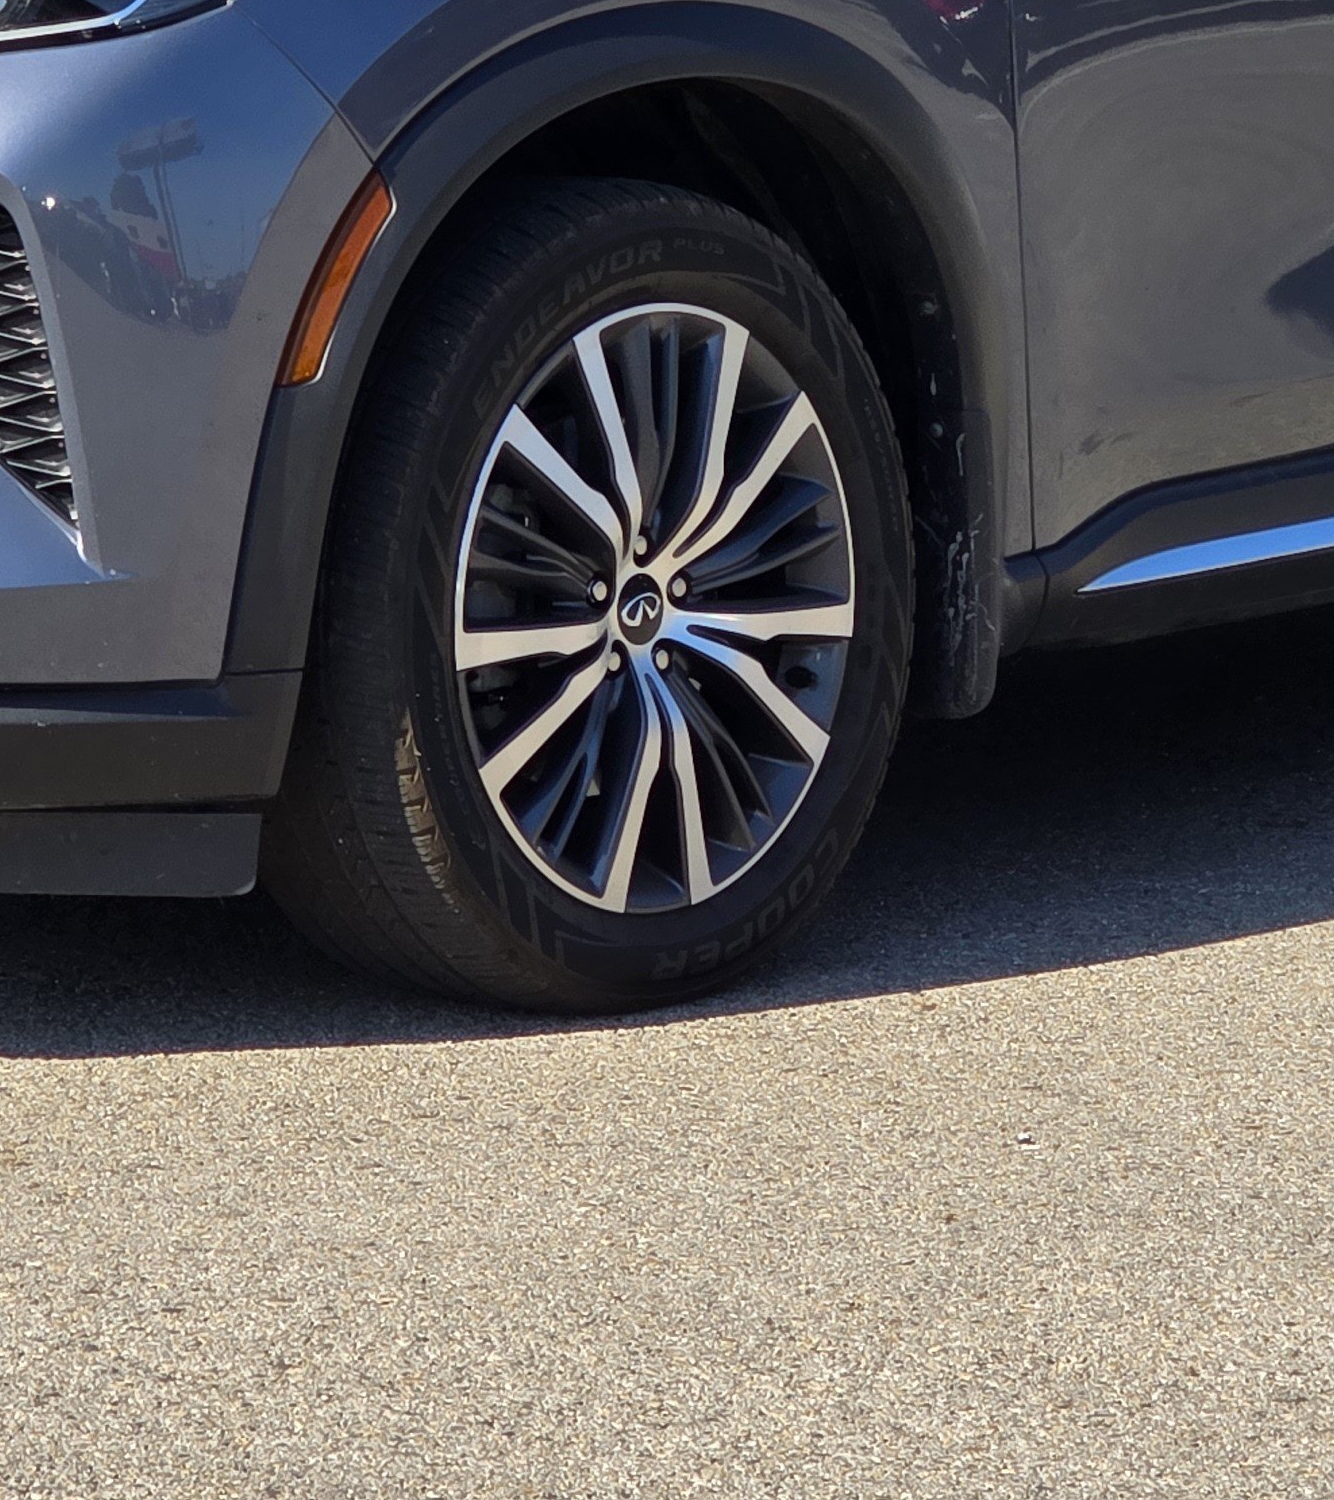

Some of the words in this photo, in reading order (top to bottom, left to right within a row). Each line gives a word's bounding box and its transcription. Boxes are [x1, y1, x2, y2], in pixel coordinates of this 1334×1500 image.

[673, 236, 726, 257] PLUS
[471, 238, 663, 420] ENDEAVOR
[652, 826, 840, 980] COOPER
